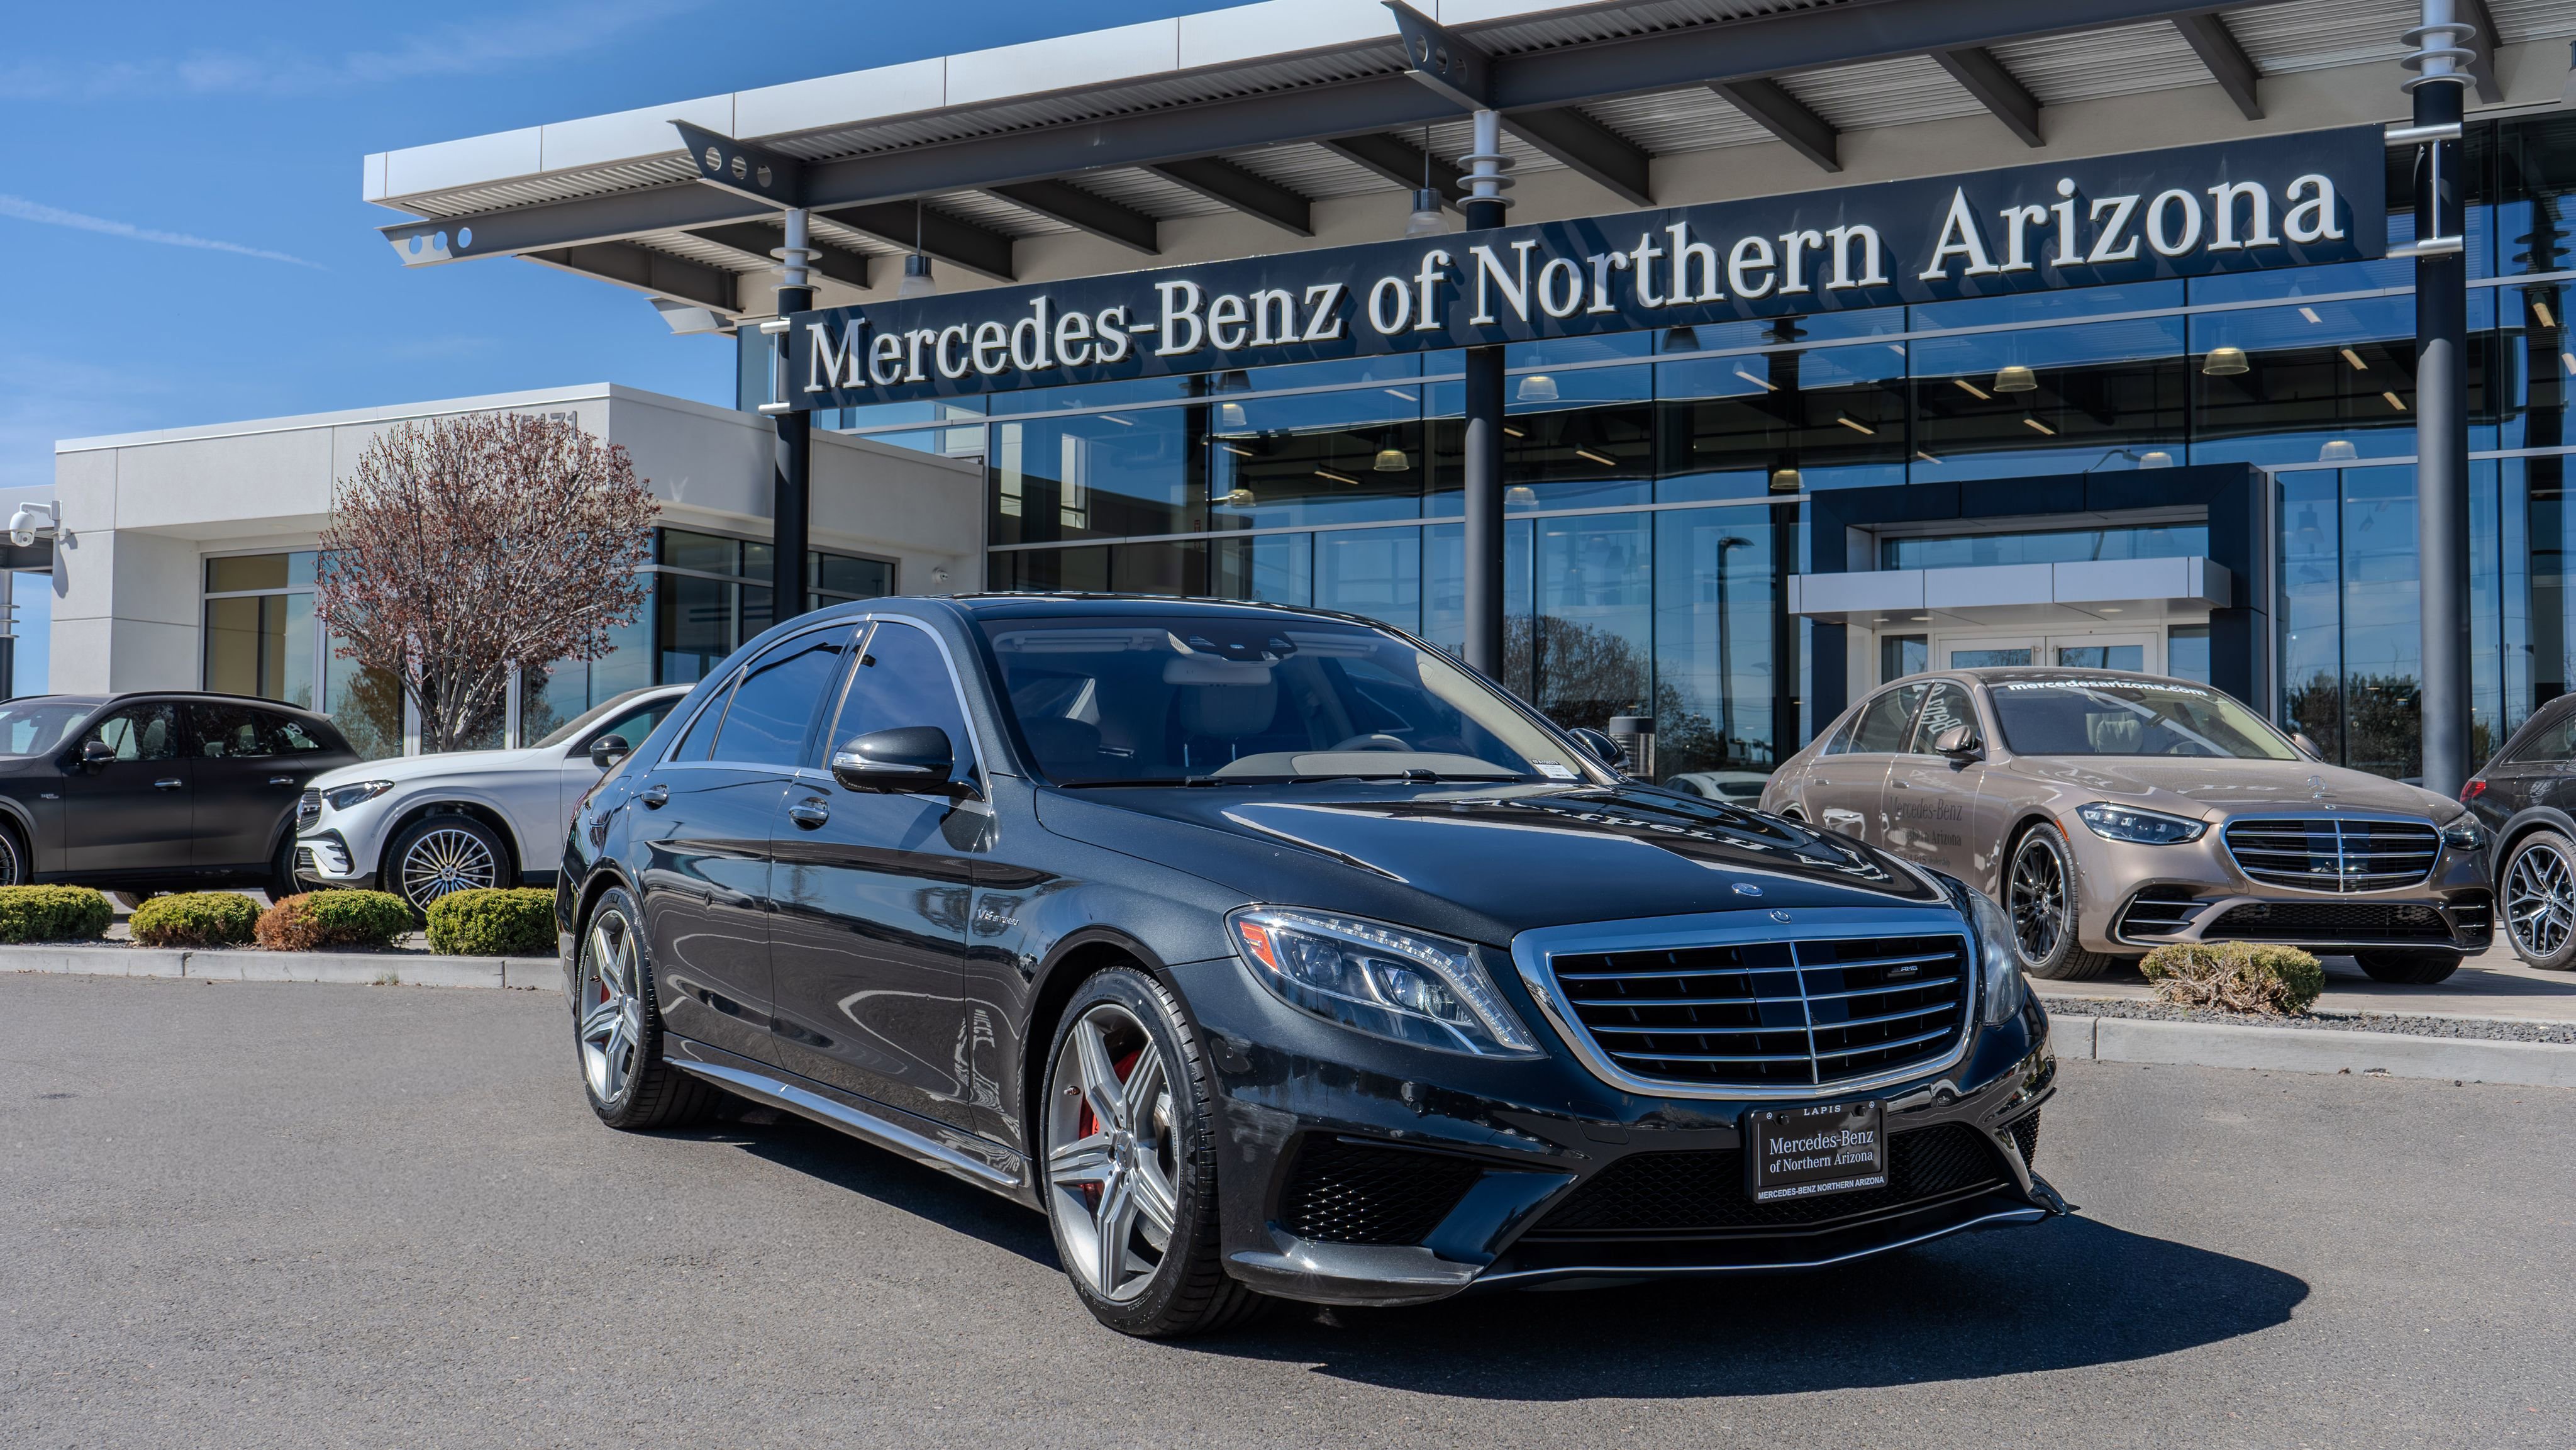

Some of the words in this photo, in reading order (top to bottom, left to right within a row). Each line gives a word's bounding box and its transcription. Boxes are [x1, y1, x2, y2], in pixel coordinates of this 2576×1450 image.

[804, 279, 1343, 393] Mercedes-Benz
[1368, 249, 1452, 335] of
[1469, 223, 1889, 325] Northern
[1920, 174, 2345, 280] Arizona
[2007, 680, 2209, 696] mercedesarizona.com
[1931, 829, 1962, 846] Arizona
[1804, 1105, 1841, 1115] LAPIS
[1769, 1130, 1874, 1155] Mercedes-Benz
[1769, 1161, 1780, 1173] of
[1783, 1157, 1831, 1171] Northern
[1834, 1151, 1873, 1165] Arizona
[1758, 1185, 1816, 1200] MERCEDES-BENZ
[1817, 1180, 1854, 1192] NORTHERN
[1855, 1176, 1884, 1187] ARIZONA
